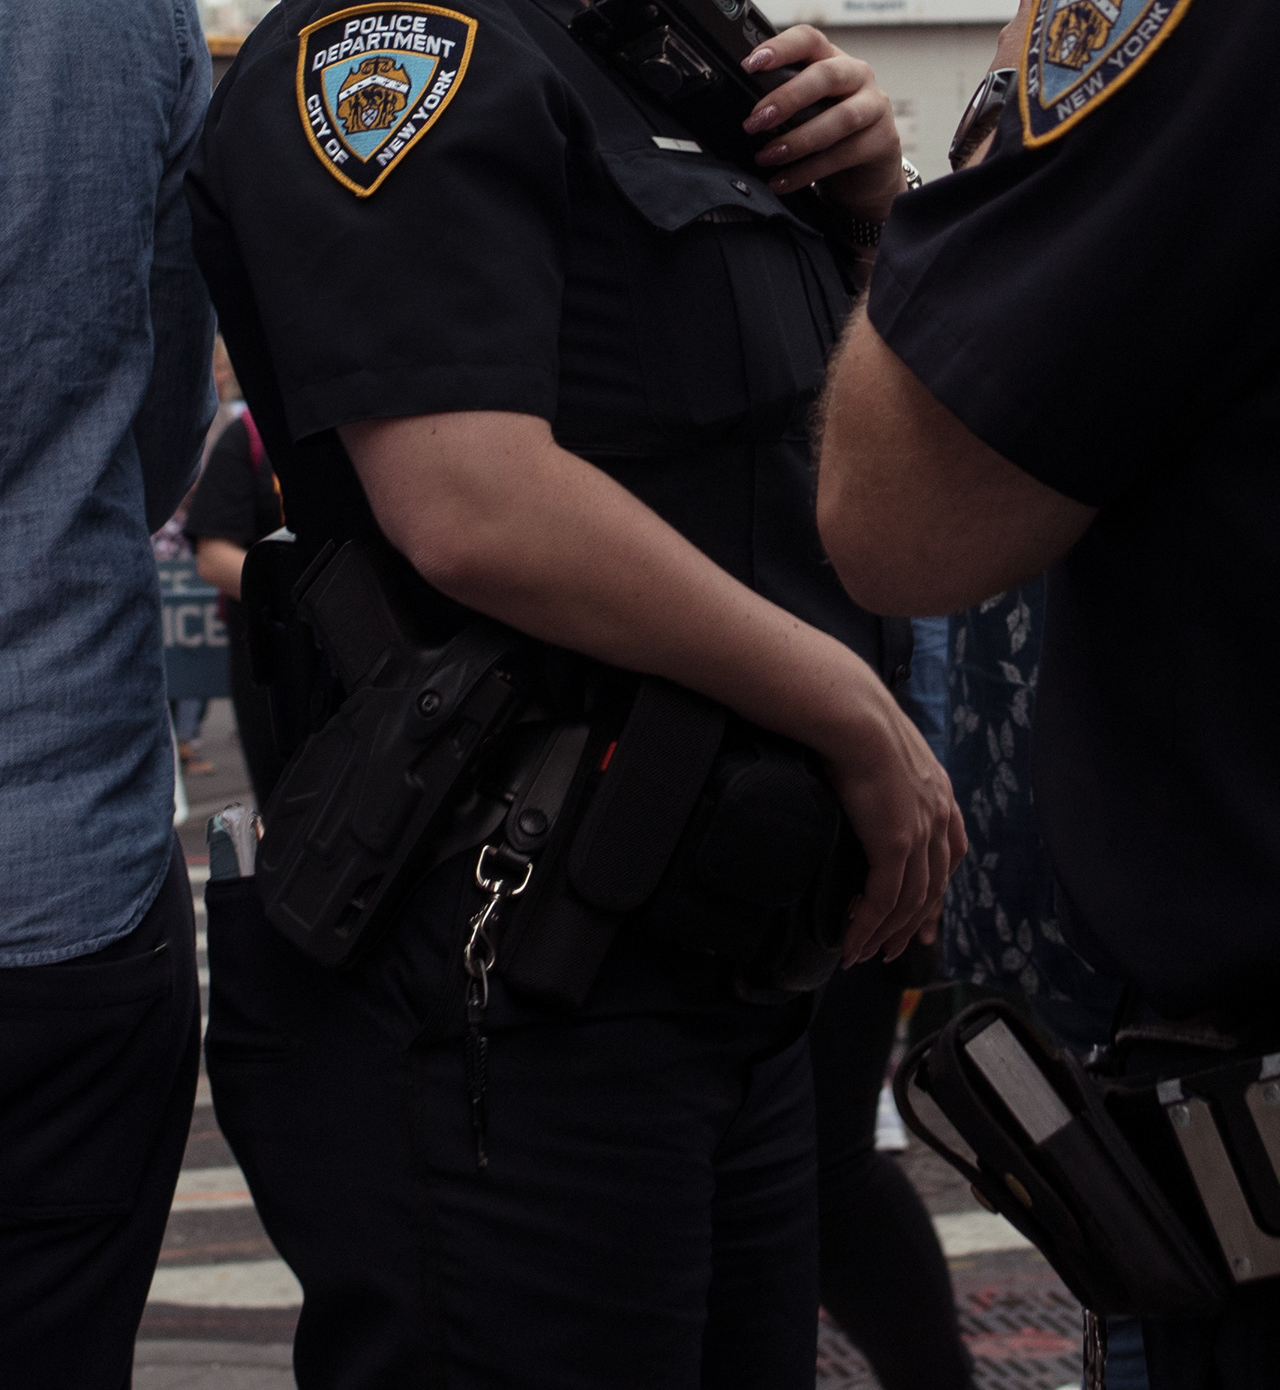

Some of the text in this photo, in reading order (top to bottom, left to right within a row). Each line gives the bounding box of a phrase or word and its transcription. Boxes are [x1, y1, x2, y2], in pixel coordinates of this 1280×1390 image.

[311, 31, 456, 72] DEPARTMENT
[343, 14, 428, 41] POLICE
[1055, 1, 1170, 122] NEW YORK
[306, 93, 350, 165] CITY OF
[375, 69, 457, 167] NEW YORK
